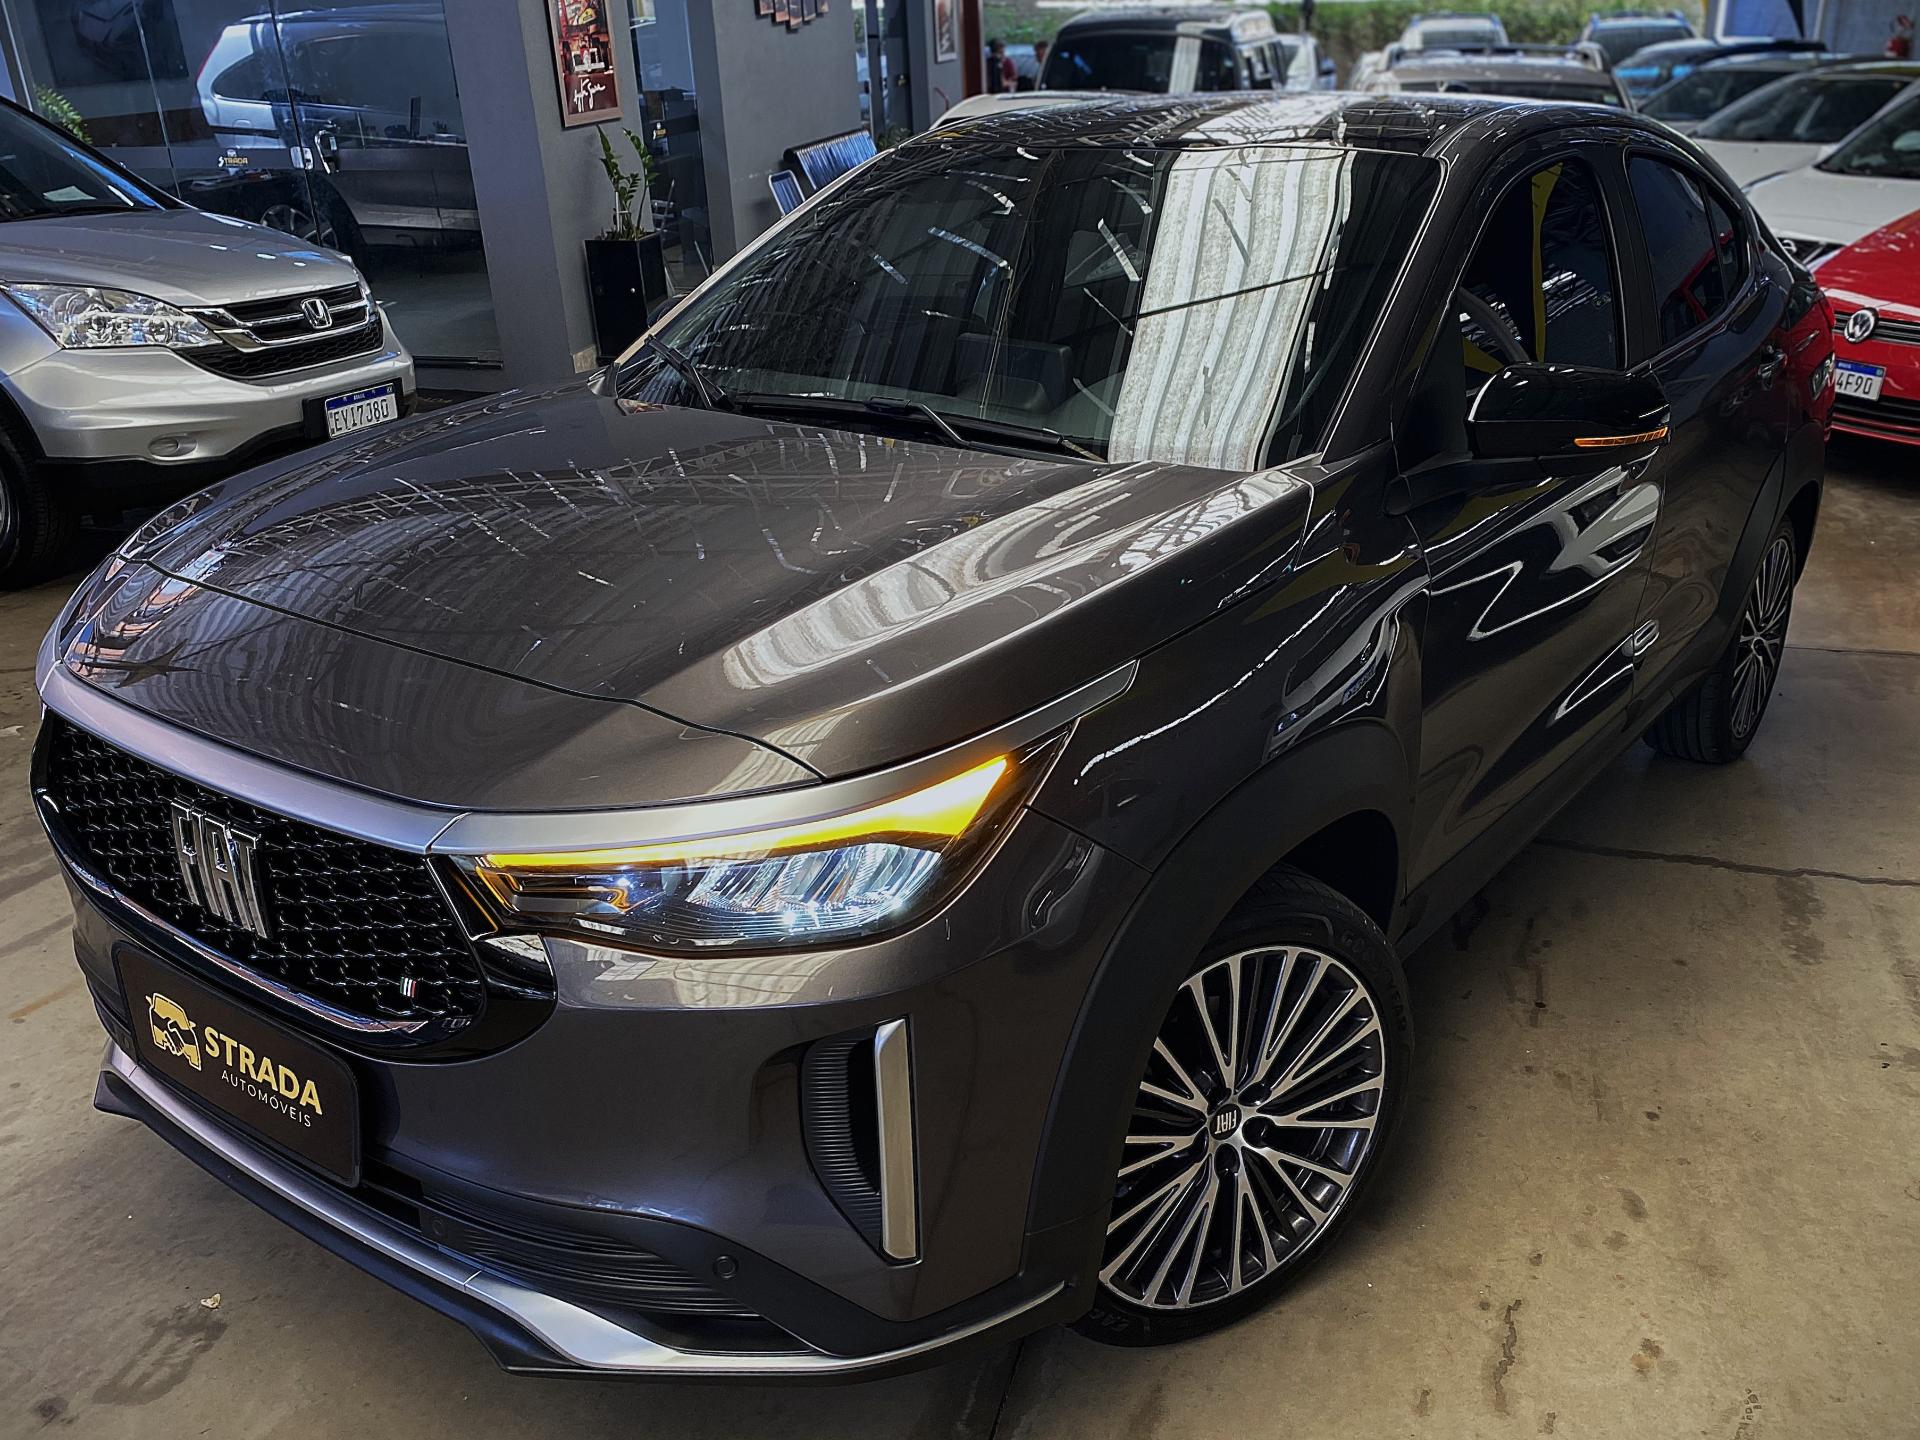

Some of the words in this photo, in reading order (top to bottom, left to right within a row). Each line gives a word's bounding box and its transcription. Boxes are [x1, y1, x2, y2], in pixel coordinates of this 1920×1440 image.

[203, 1026, 323, 1115] STRADA
[221, 1069, 312, 1128] AUTOMÓVEIS
[1214, 1109, 1237, 1135] FIAT
